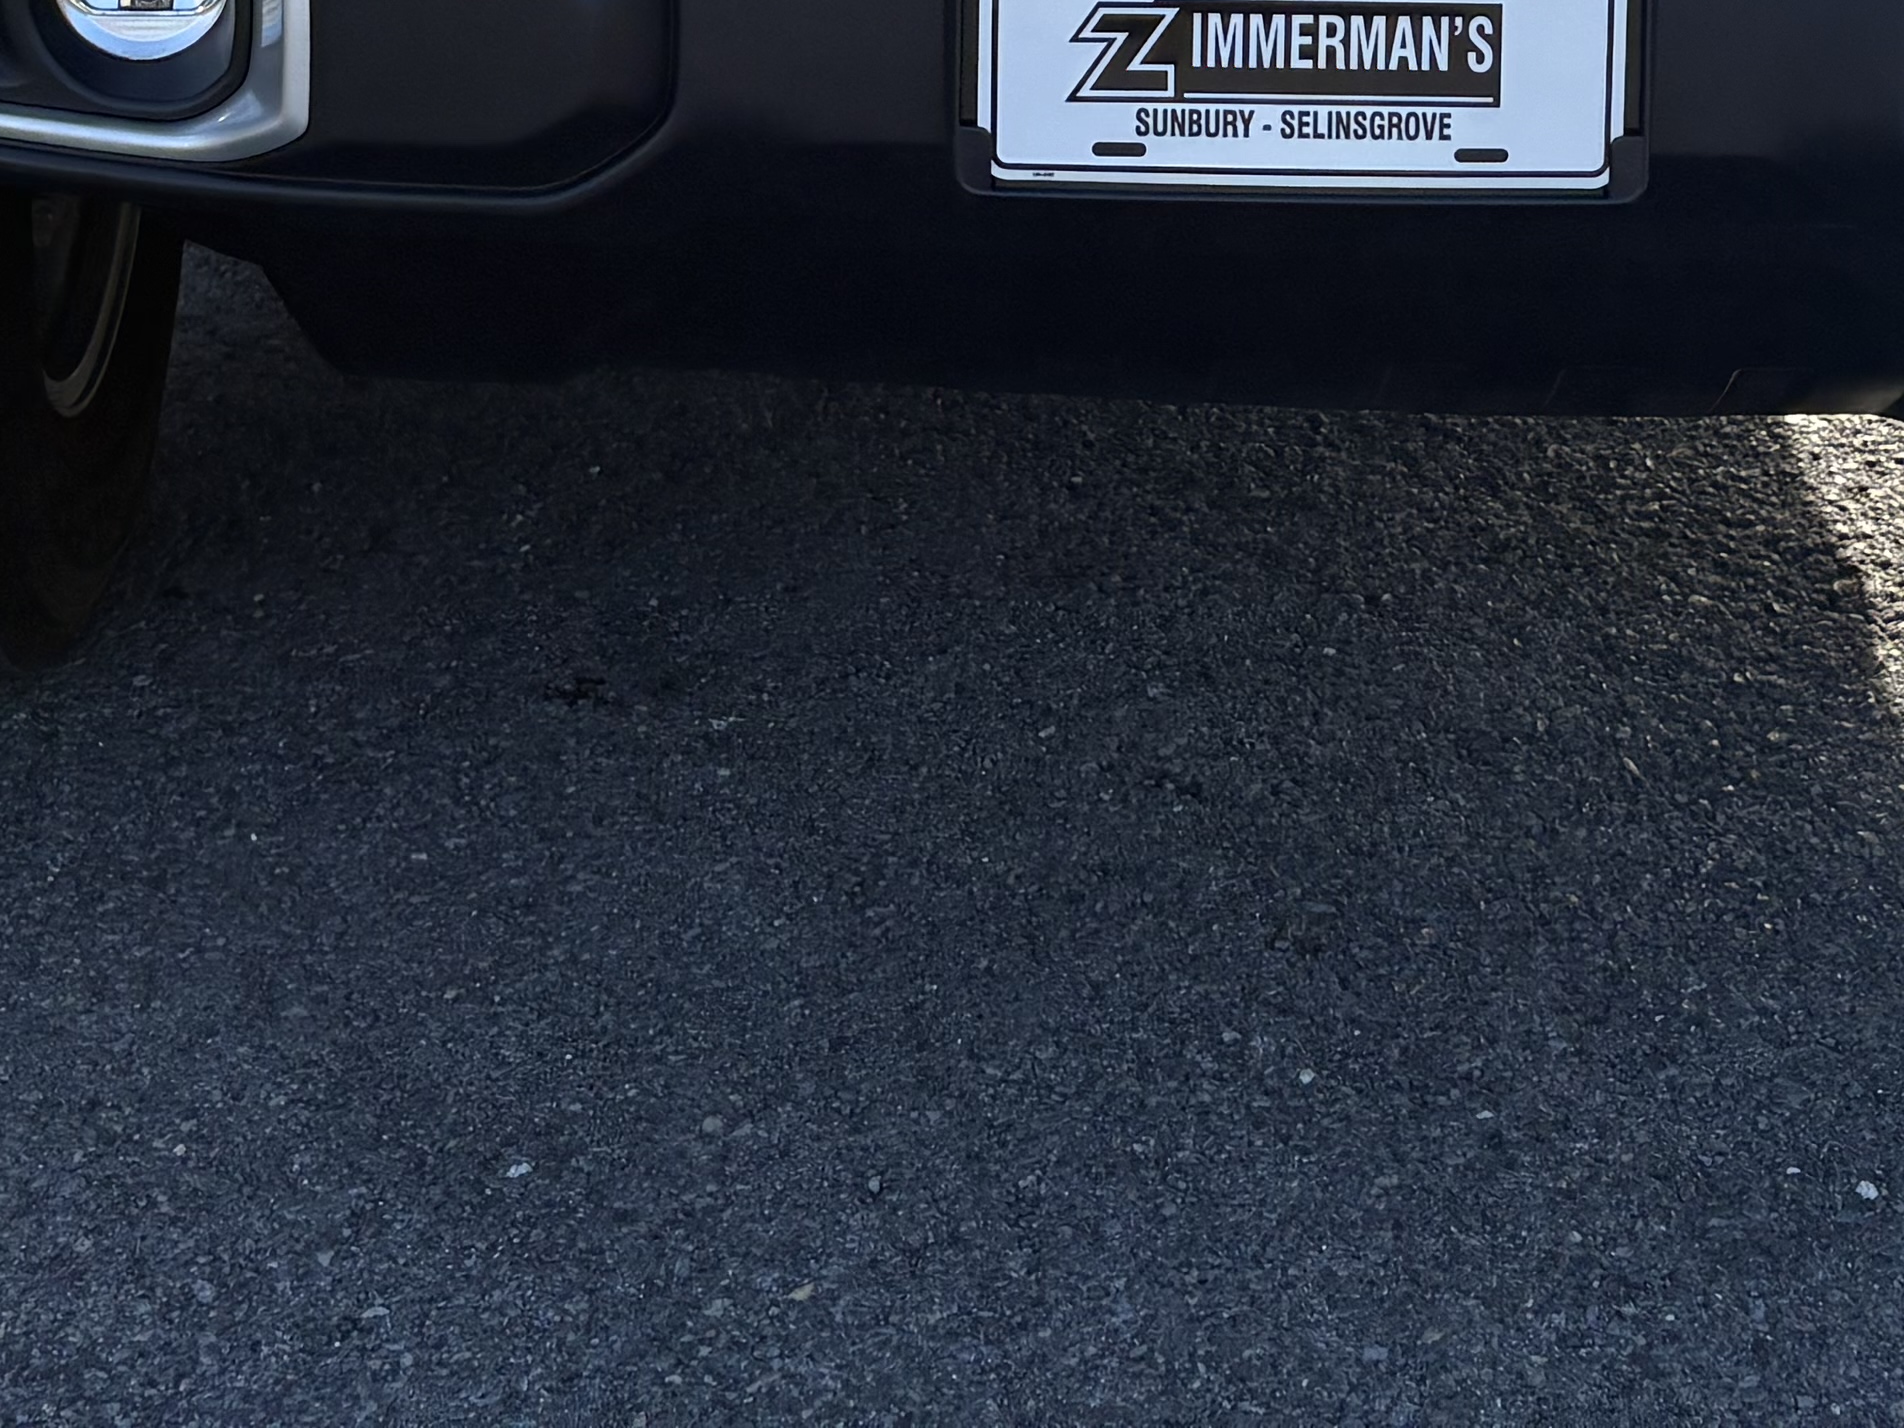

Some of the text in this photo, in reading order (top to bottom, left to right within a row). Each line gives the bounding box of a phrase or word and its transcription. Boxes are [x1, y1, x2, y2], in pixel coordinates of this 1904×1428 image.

[1066, 1, 1495, 103] ZIMMERMAN'S
[1134, 107, 1256, 140] SUNBURY
[1279, 109, 1453, 143] SELINSGROVE
